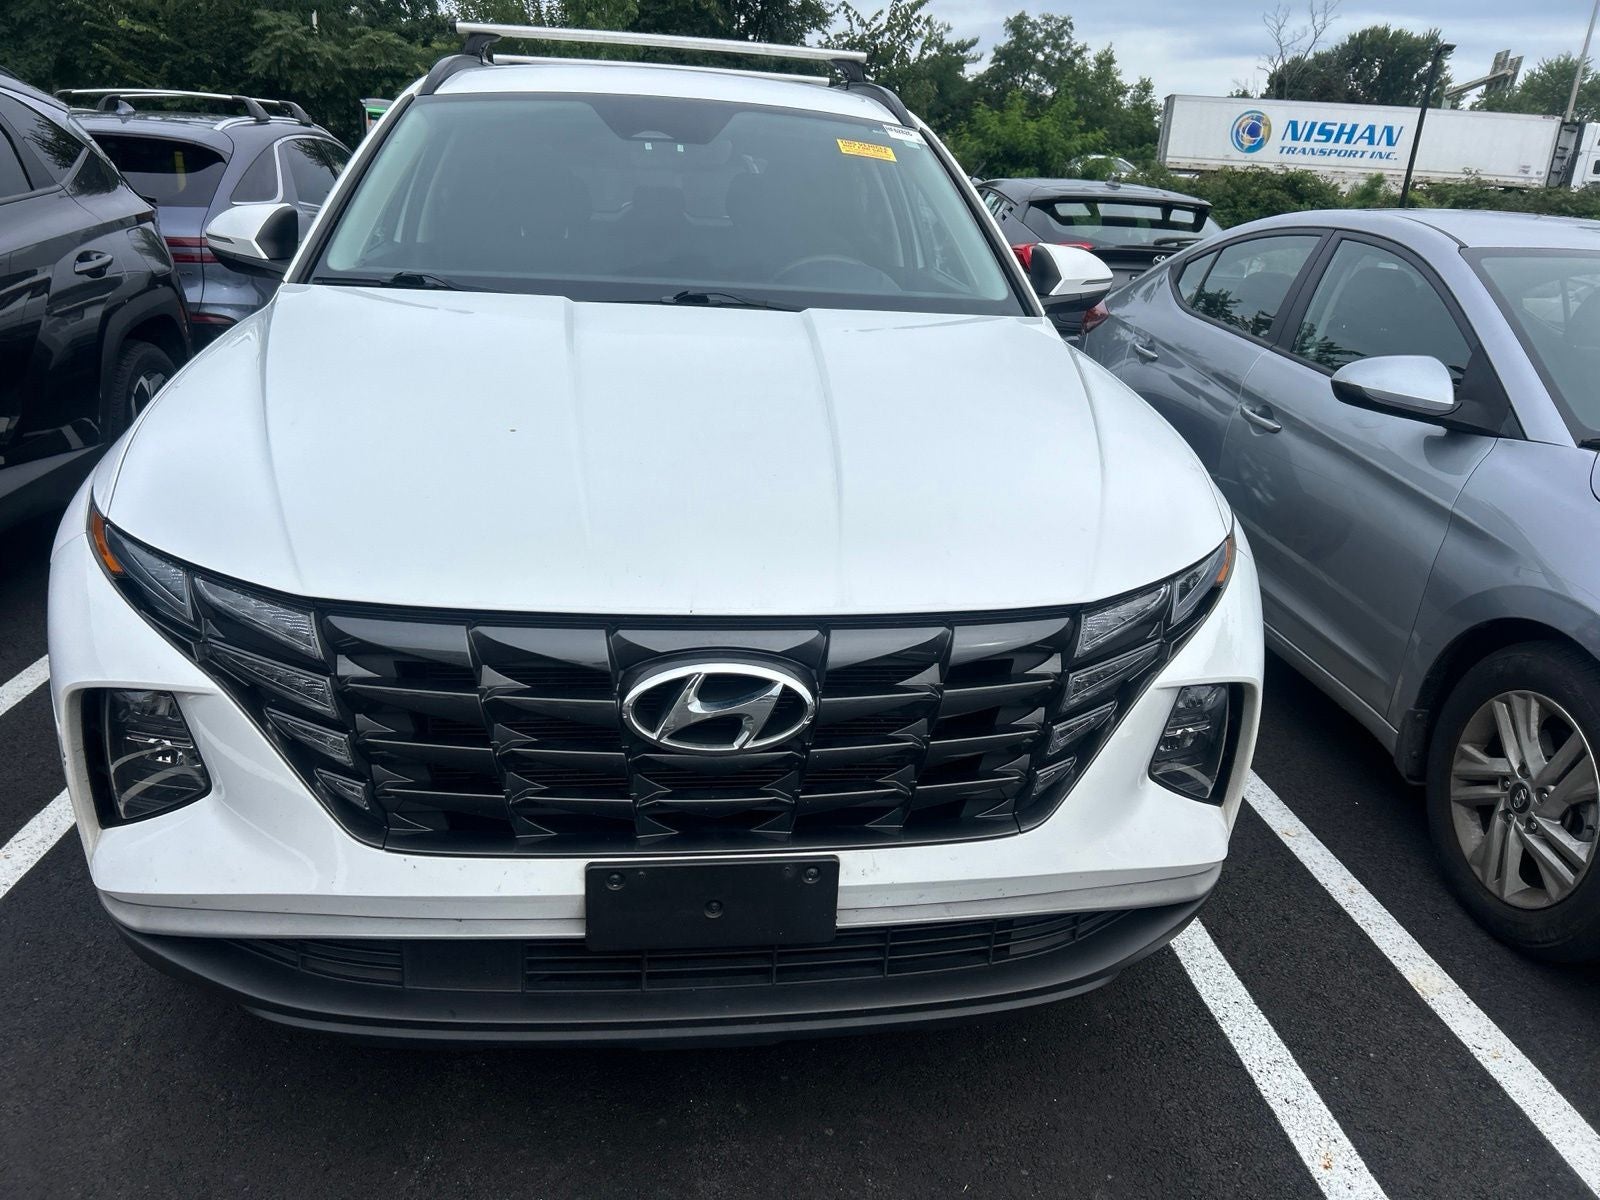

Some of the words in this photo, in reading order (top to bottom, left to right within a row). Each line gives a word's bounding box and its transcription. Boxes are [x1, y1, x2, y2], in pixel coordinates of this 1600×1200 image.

[1281, 120, 1404, 147] NISHAN
[1279, 146, 1368, 158] TRANSPORT
[1370, 151, 1398, 160] INC.
